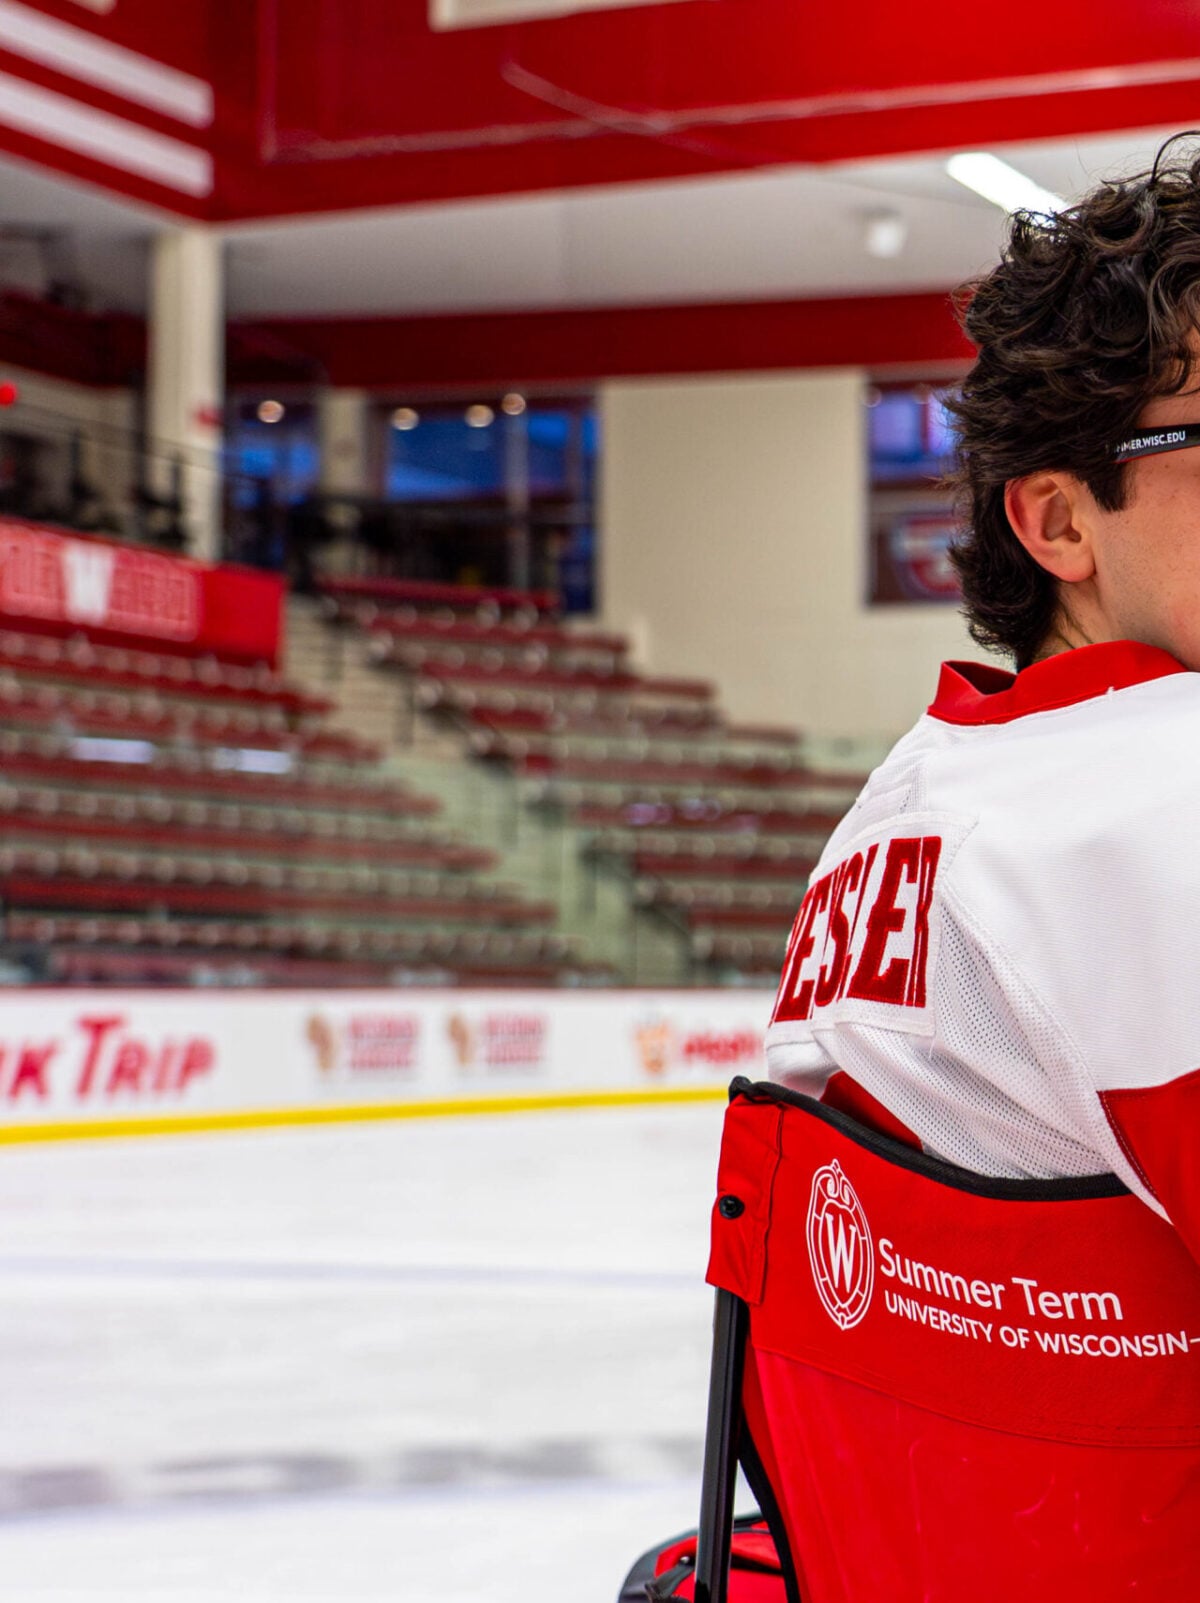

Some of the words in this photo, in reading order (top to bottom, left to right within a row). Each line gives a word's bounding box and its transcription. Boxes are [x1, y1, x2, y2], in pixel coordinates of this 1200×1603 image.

[825, 1212, 858, 1295] W
[878, 1238, 1006, 1311] Summer
[1011, 1277, 1124, 1321] Term
[884, 1289, 993, 1344] UNIVERSITY
[999, 1325, 1031, 1350] OF
